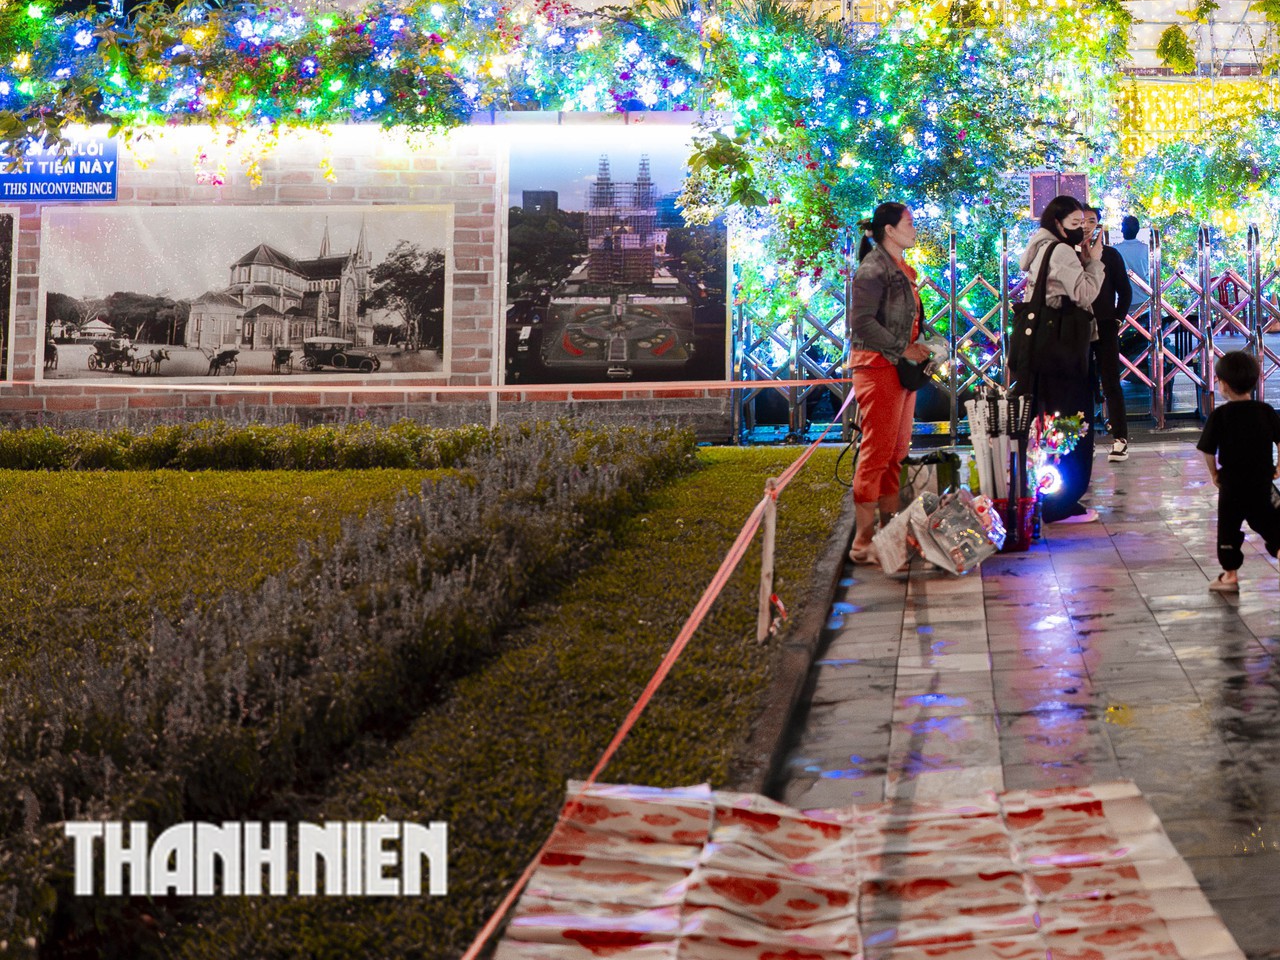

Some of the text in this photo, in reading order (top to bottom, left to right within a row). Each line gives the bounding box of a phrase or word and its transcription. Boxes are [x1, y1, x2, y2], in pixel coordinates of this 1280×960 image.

[80, 158, 114, 174] NÀY
[4, 181, 112, 195] THIS INCONVENIENCE
